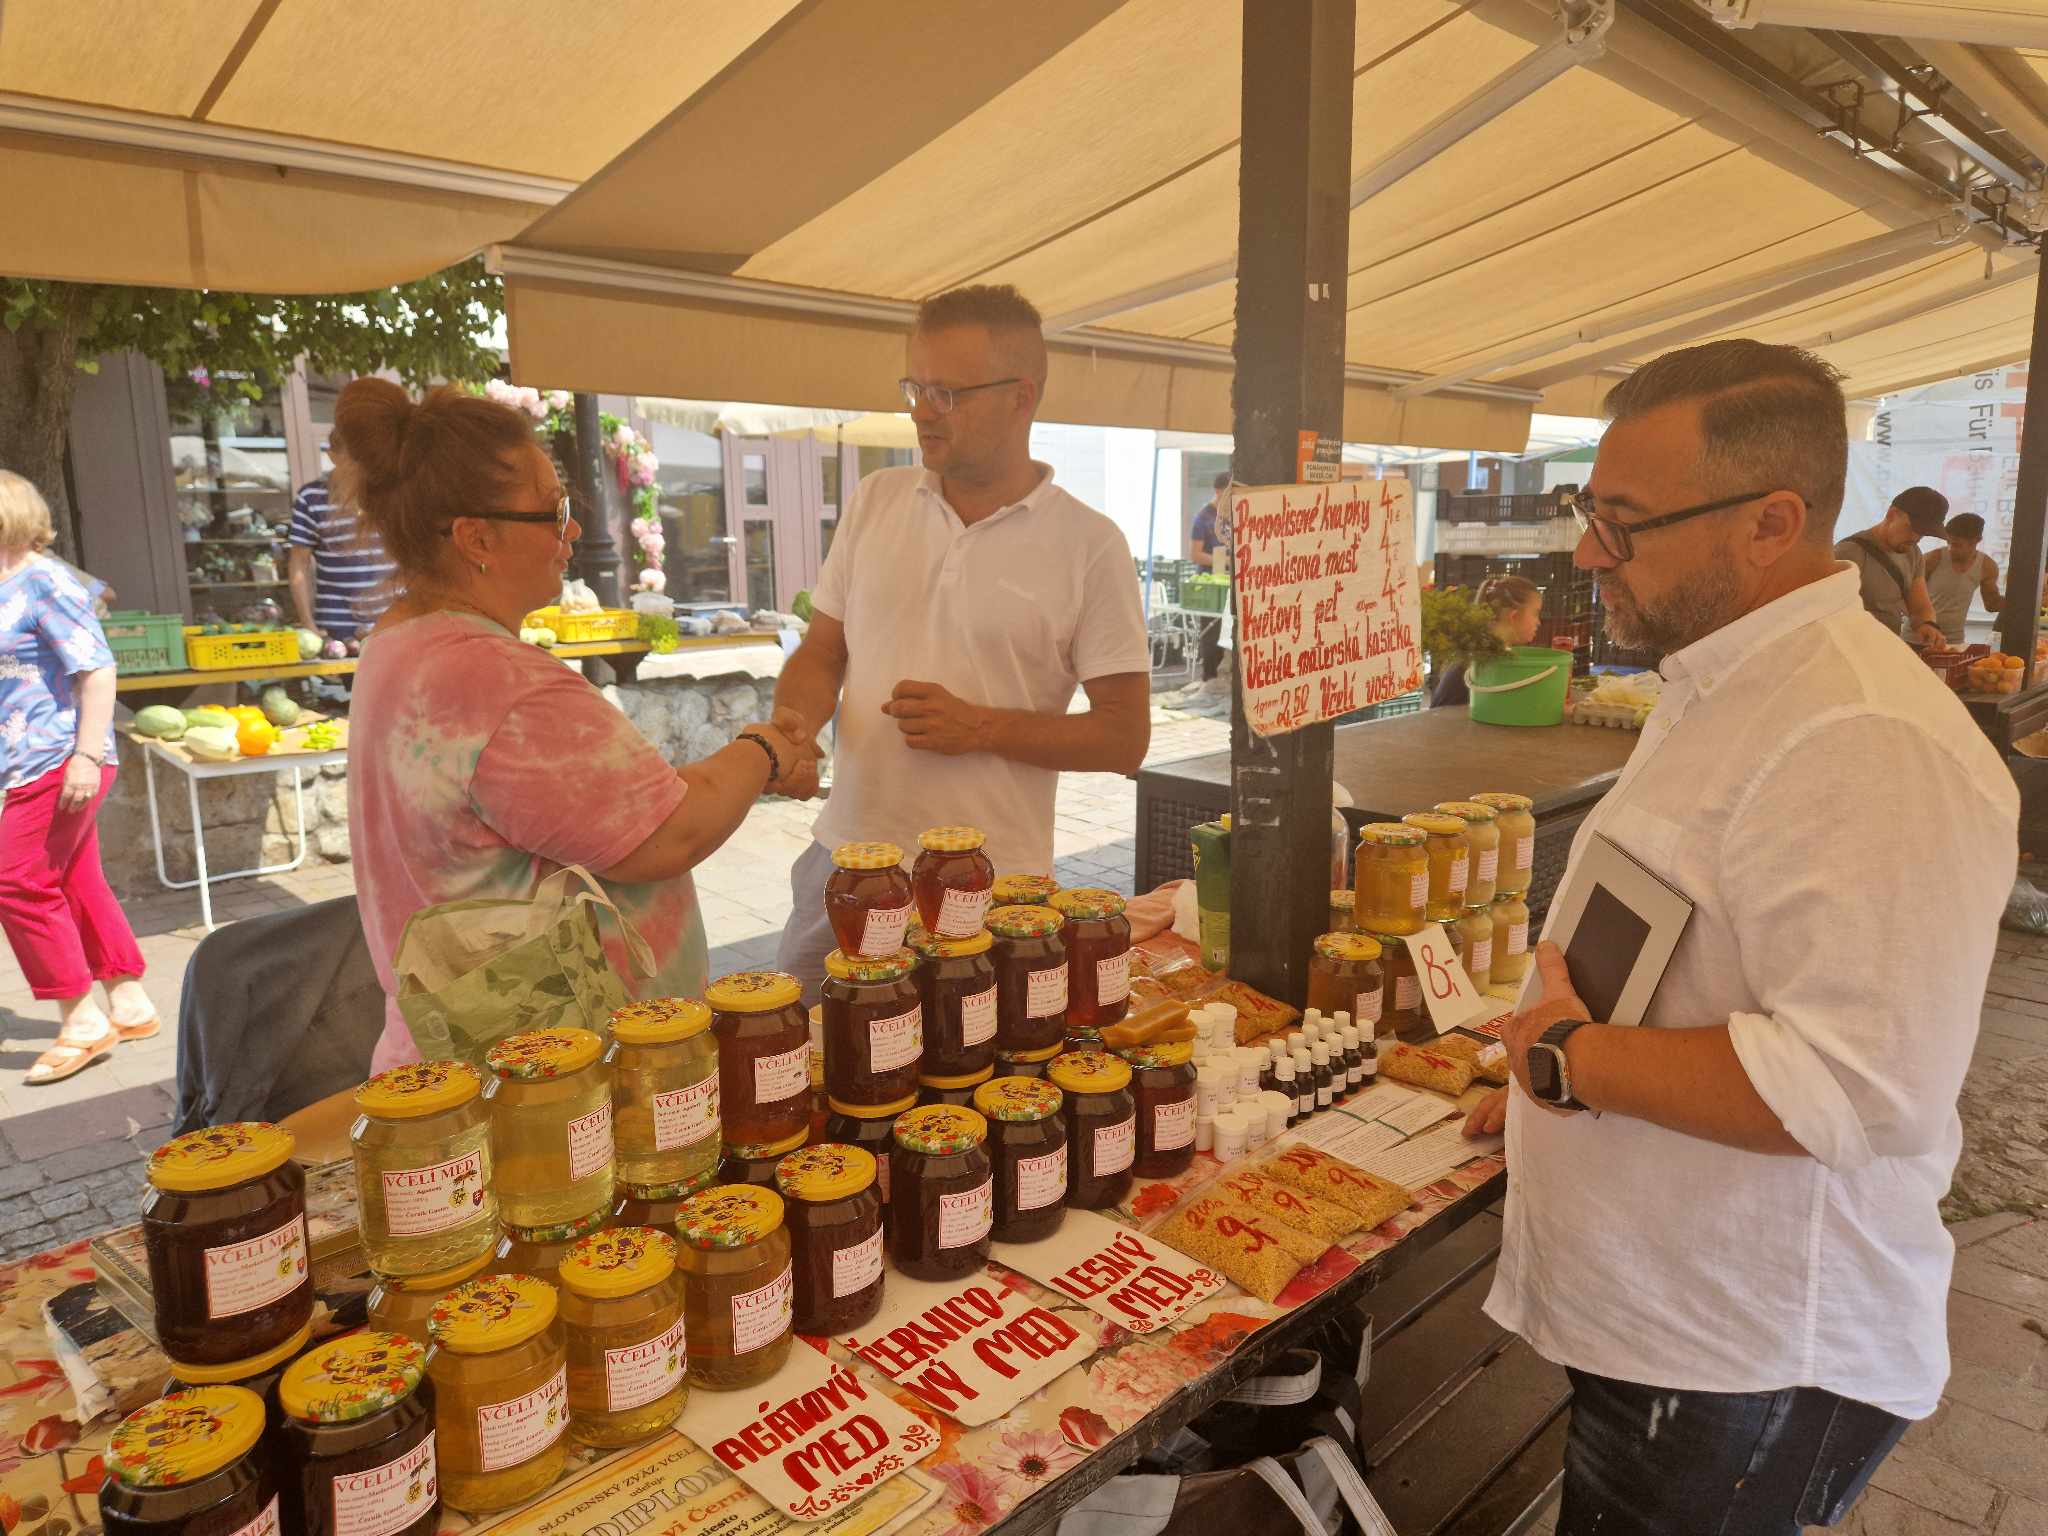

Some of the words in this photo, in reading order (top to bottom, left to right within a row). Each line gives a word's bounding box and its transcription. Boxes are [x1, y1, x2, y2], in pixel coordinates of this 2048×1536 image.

[1968, 403, 1994, 440] Für
[1233, 493, 1321, 551] Propolisové
[1320, 485, 1370, 540] kvapky
[1234, 540, 1322, 601] Propolisová
[1241, 589, 1303, 643] Kvetový
[1242, 637, 1295, 690] Včelia
[441, 1159, 474, 1180] MED
[1050, 1231, 1157, 1300] LESNÝ
[1106, 1265, 1194, 1320] MED
[901, 1358, 981, 1412] VÝ
[972, 1306, 1081, 1380] MED
[400, 1444, 429, 1472] MED
[782, 1413, 890, 1493] MED
[538, 1481, 621, 1534] SLOVENSKÝ
